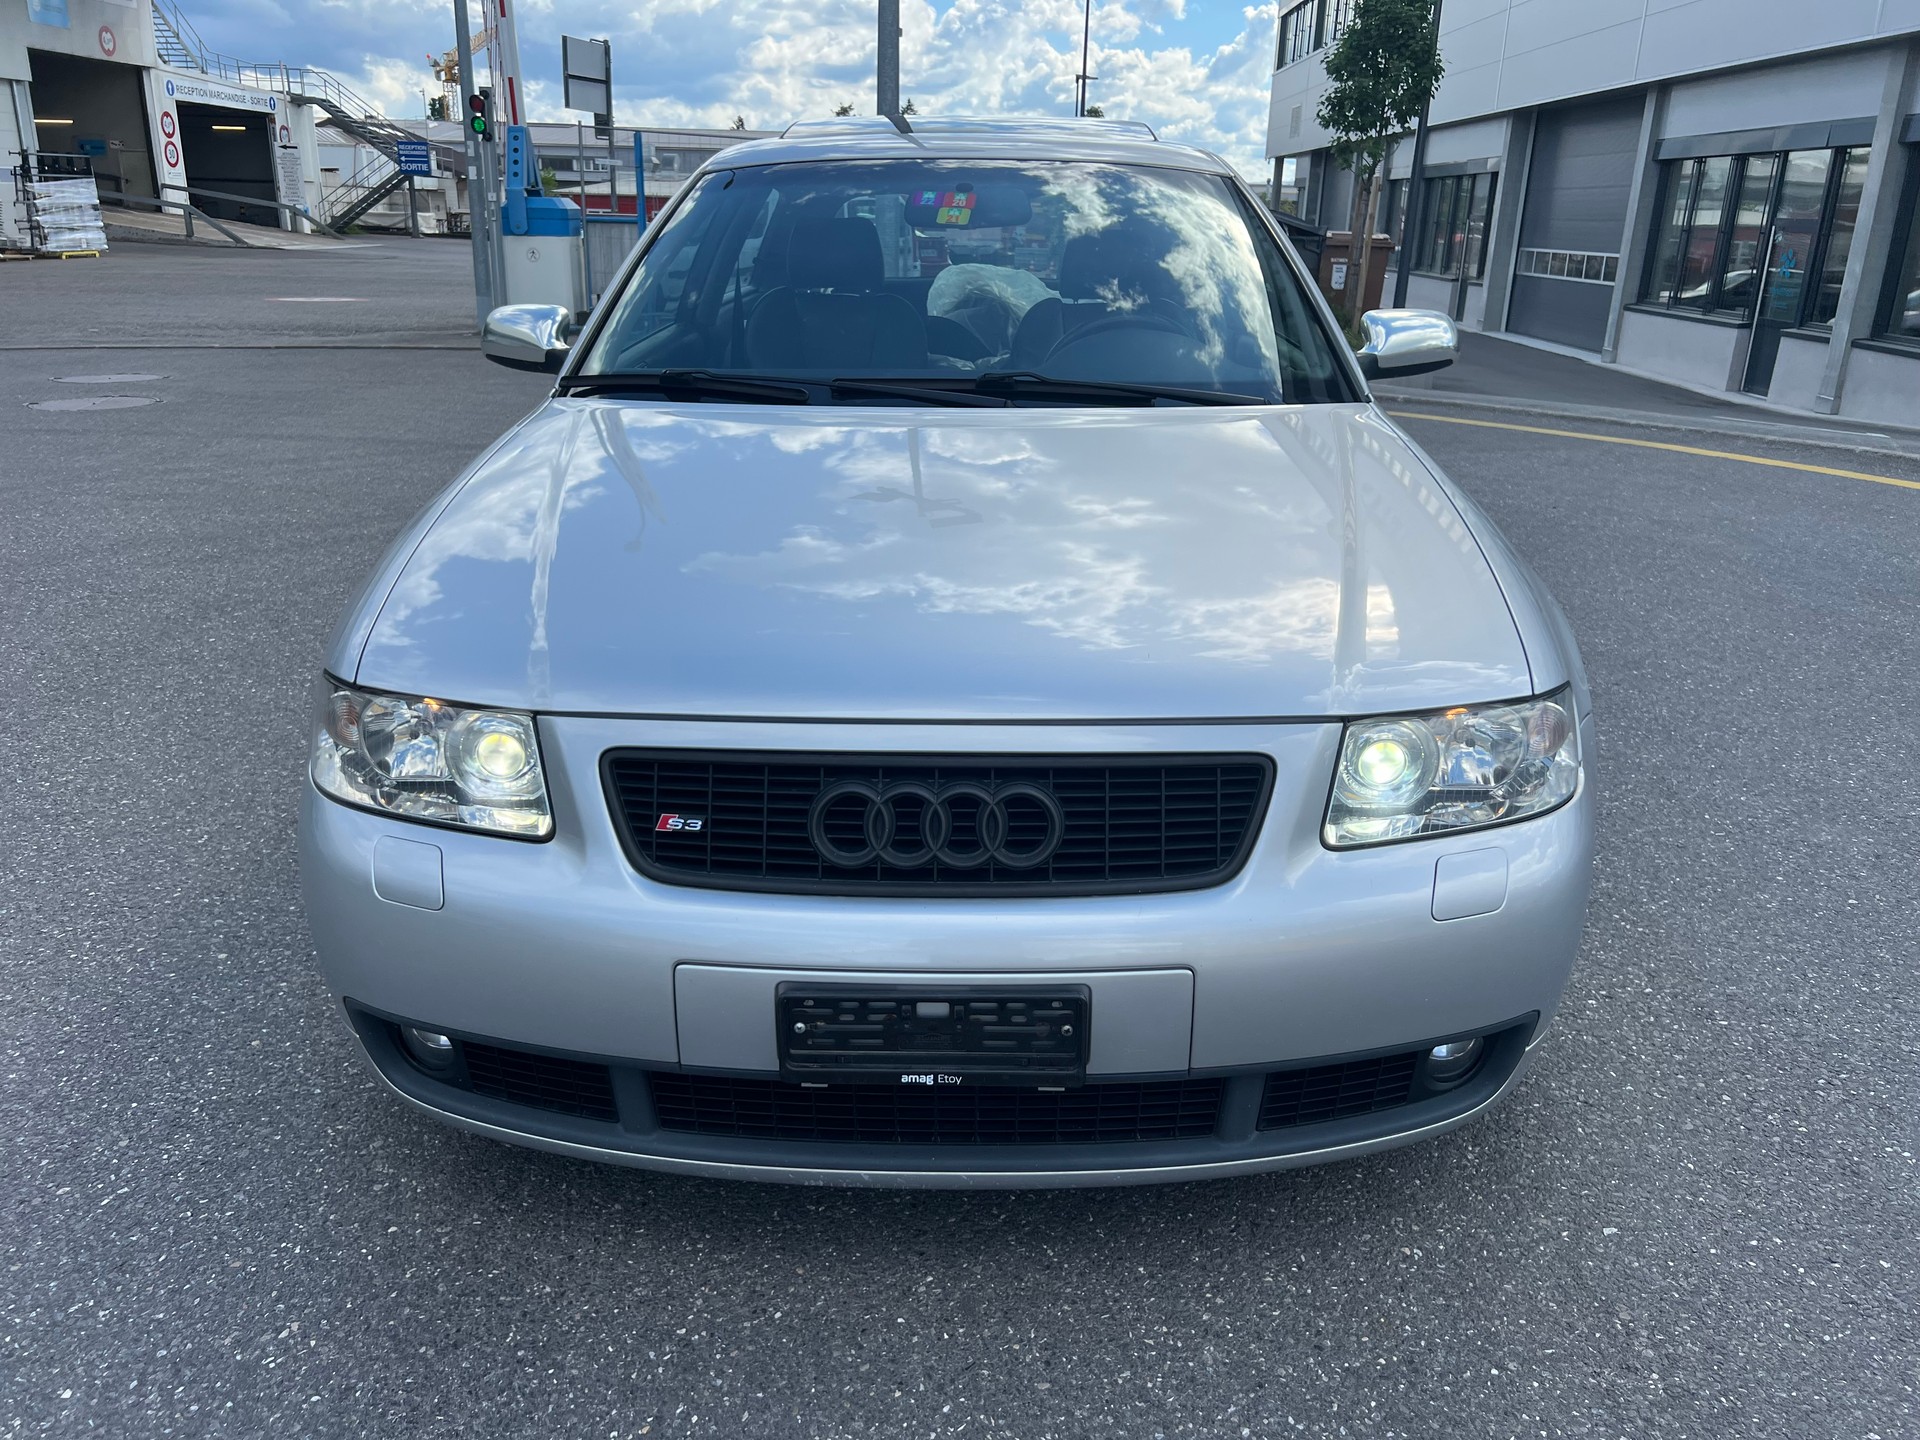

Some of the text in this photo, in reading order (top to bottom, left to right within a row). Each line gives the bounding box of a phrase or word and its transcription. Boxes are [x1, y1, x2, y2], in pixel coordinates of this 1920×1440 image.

[175, 84, 208, 97] RECEPTION
[208, 89, 247, 104] MARCHANDISE
[250, 97, 268, 107] SORTIE
[401, 163, 429, 171] SORTIE
[920, 197, 935, 205] 22
[952, 199, 967, 207] 20
[666, 818, 702, 830] S3
[901, 1074, 962, 1085] amag Etoy
